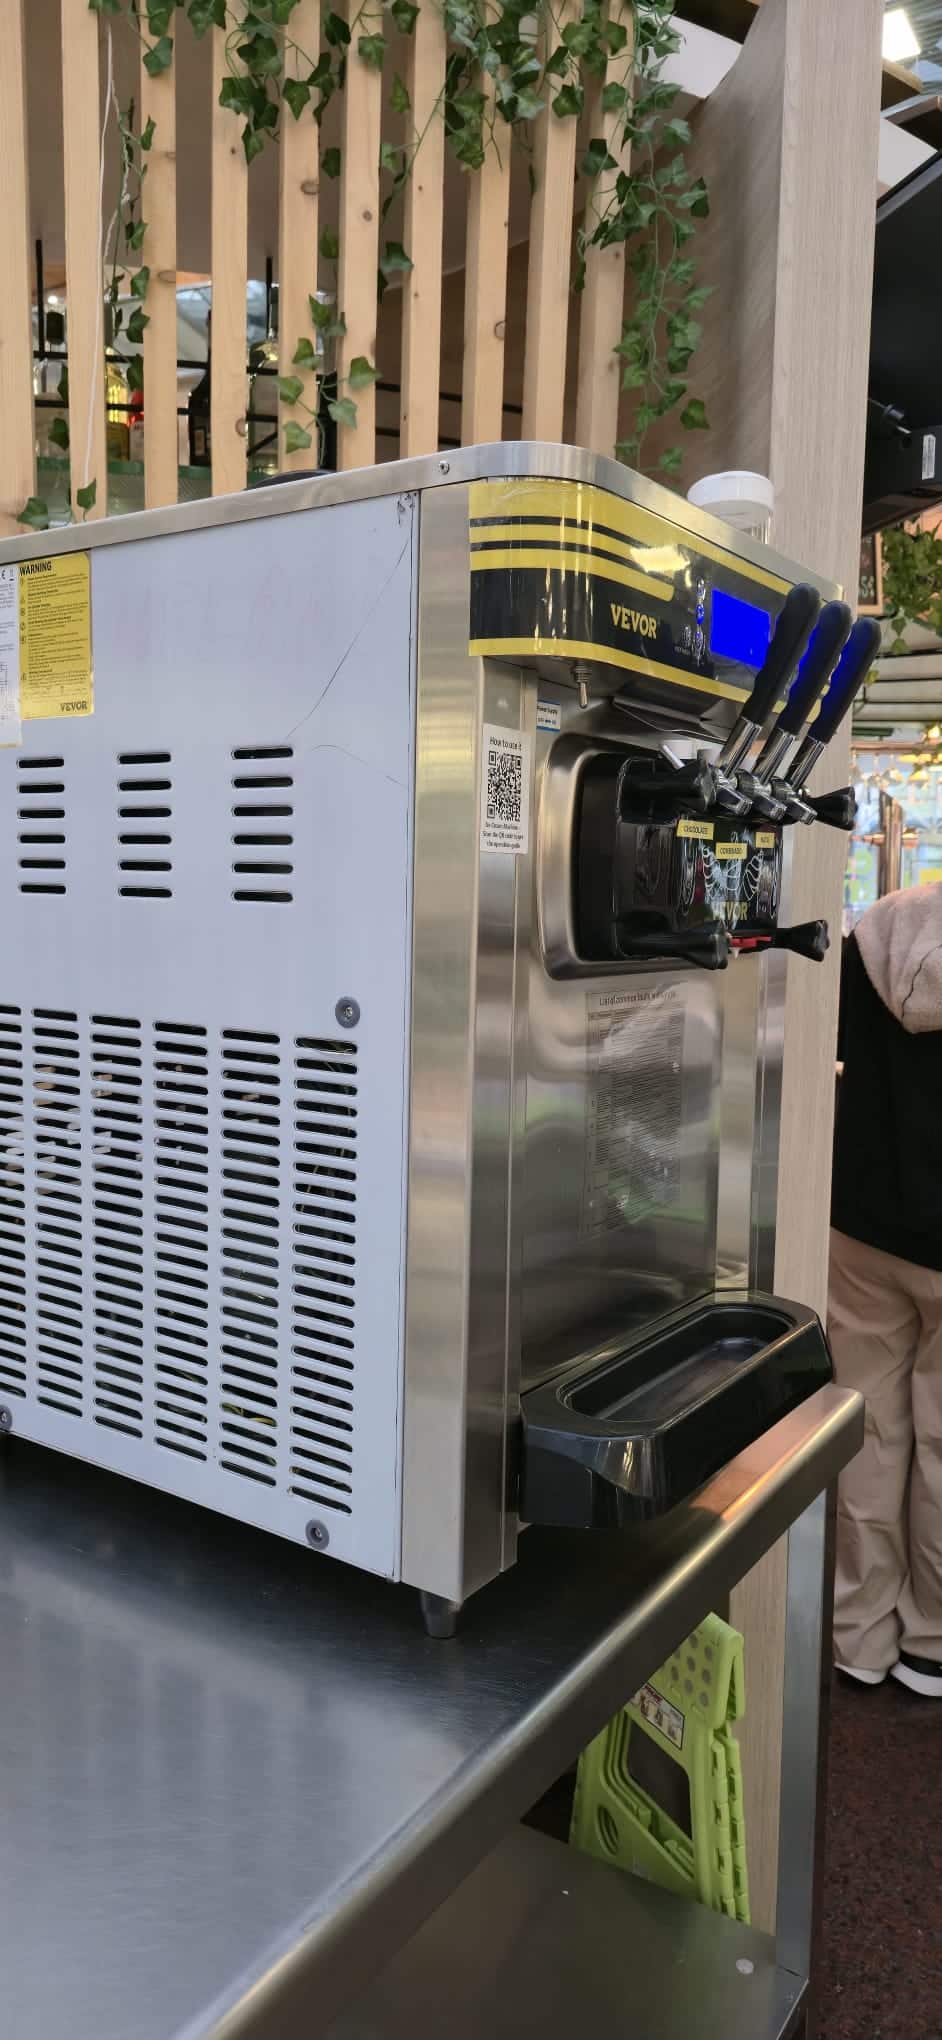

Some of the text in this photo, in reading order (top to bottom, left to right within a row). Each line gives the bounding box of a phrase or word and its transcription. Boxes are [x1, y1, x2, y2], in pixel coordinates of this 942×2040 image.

[20, 561, 52, 576] WARNING
[610, 603, 657, 639] VEVOR
[60, 700, 88, 712] VEVOR
[683, 824, 708, 835] CHOCOLATE
